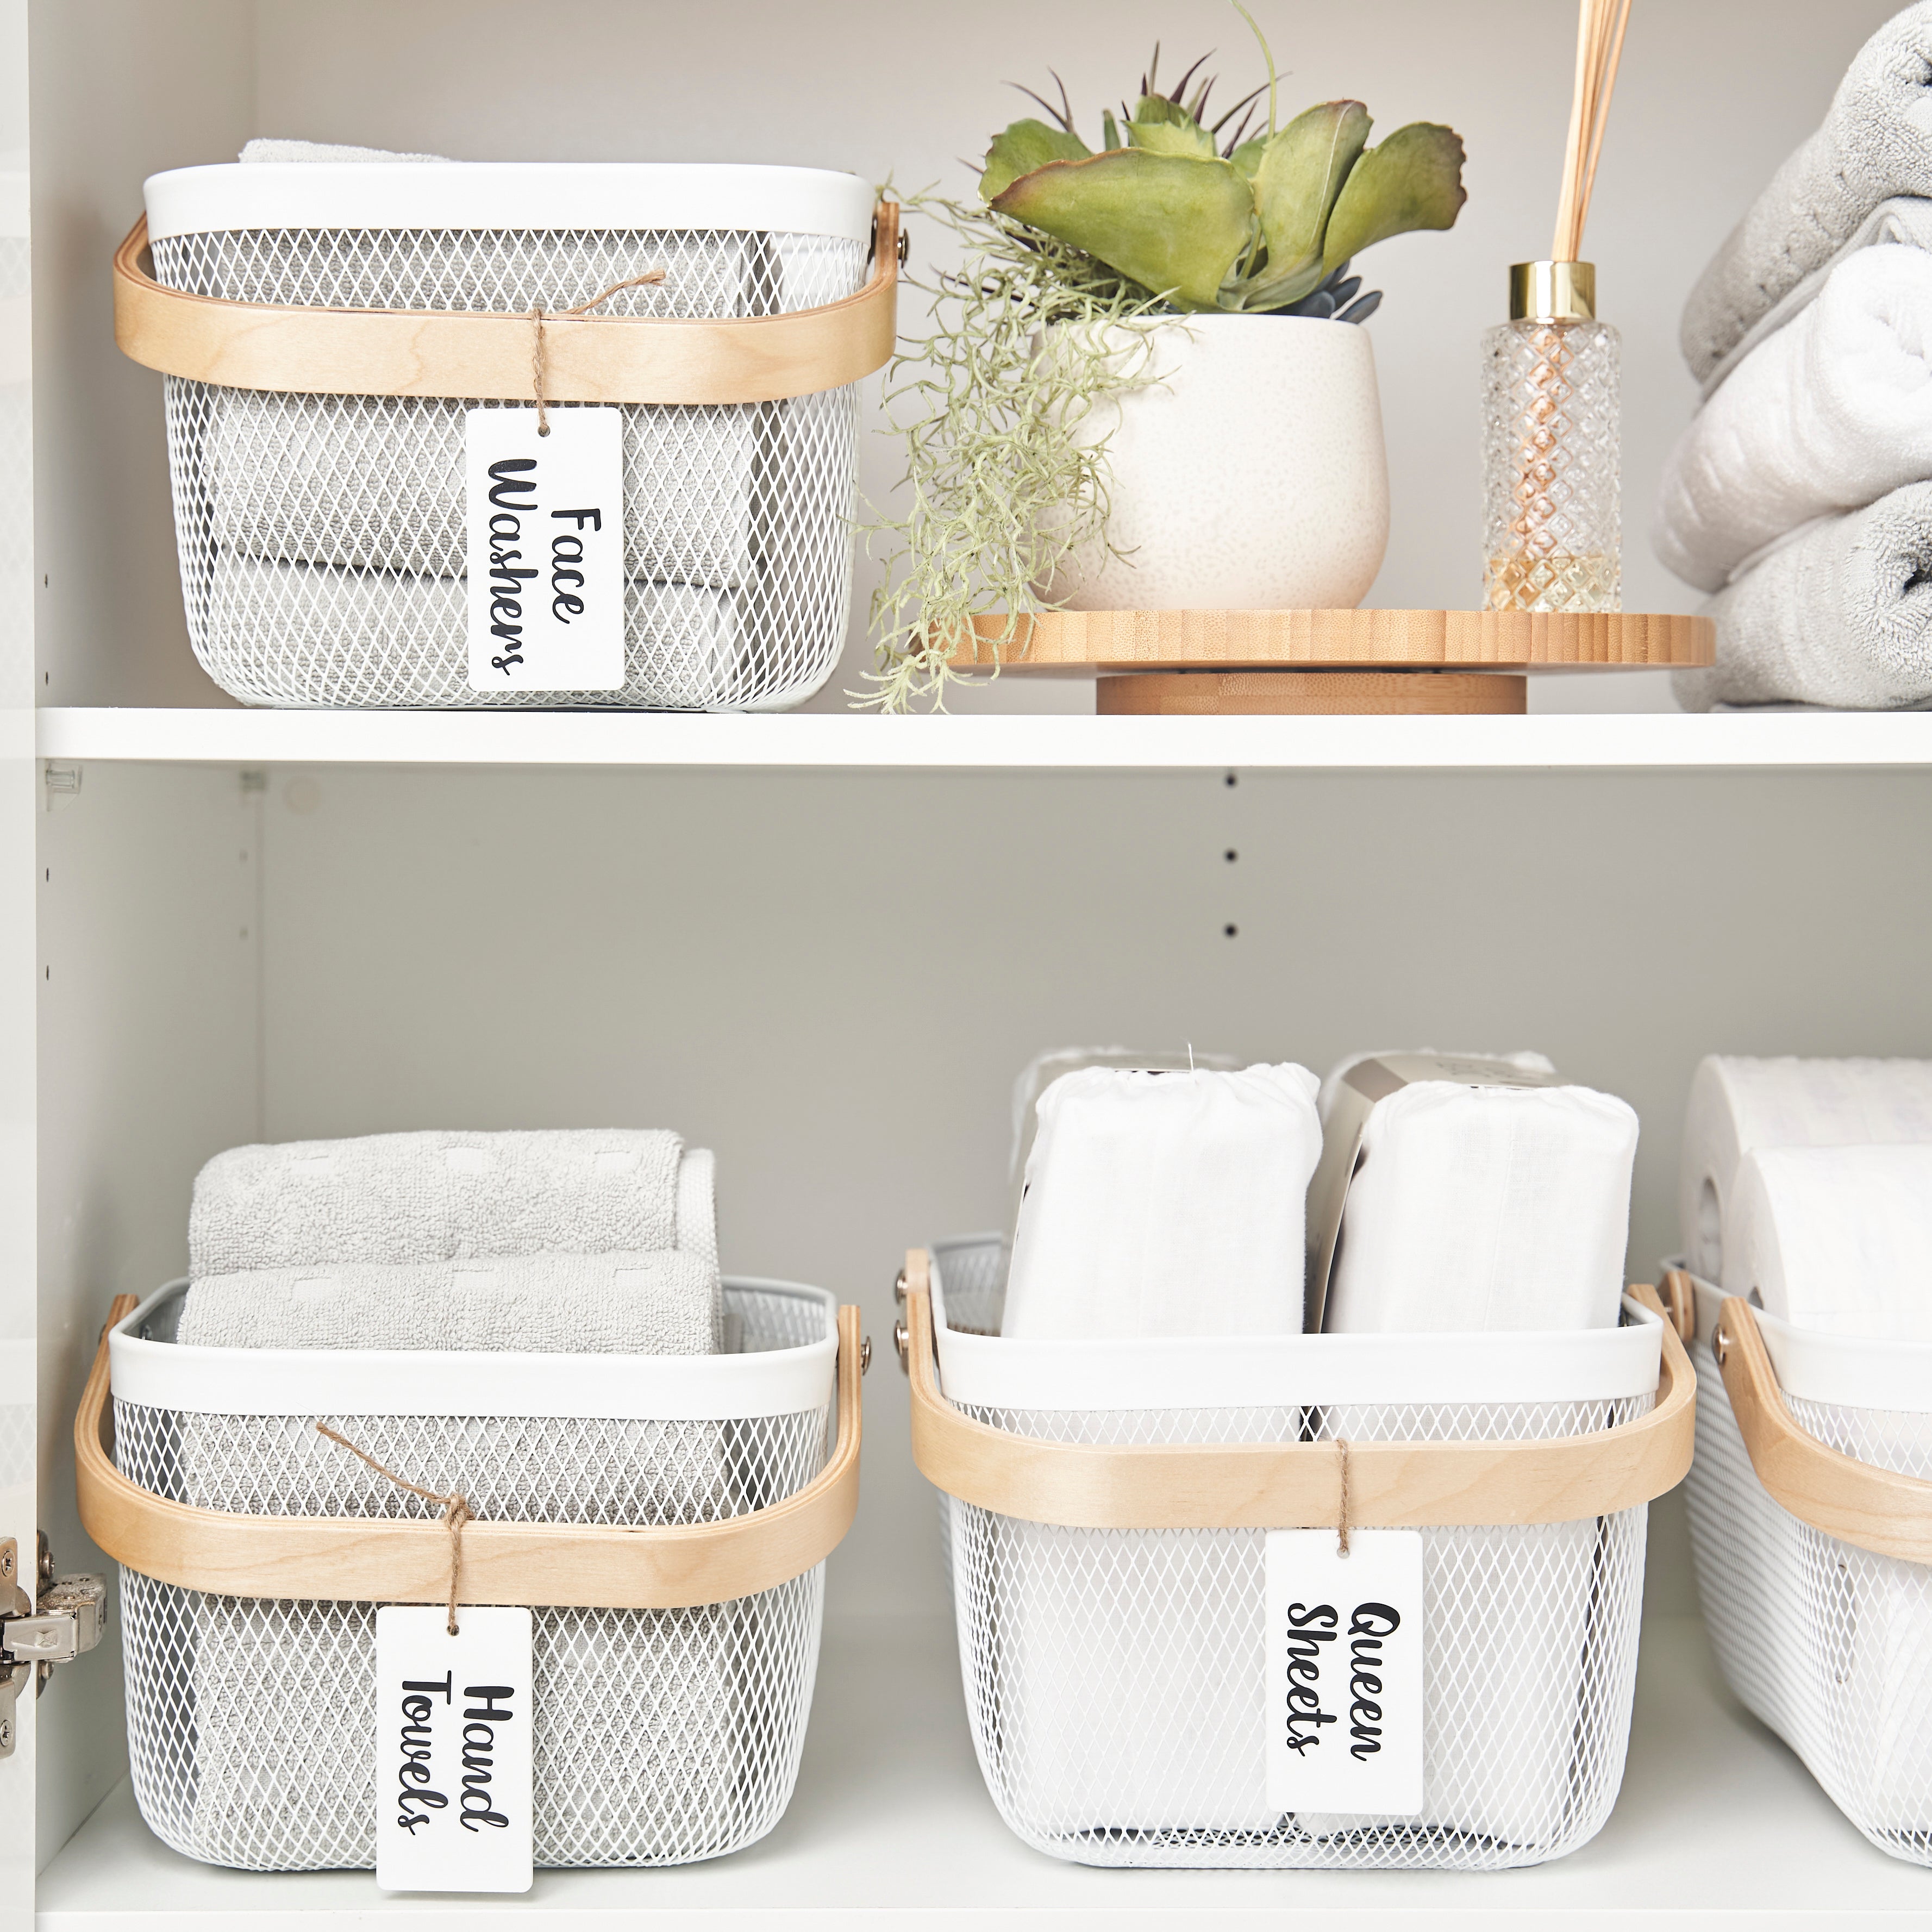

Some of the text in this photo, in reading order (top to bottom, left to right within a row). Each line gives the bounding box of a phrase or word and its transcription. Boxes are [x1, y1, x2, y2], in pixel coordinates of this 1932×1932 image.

[489, 459, 539, 676] Washers
[551, 508, 602, 624] Face
[397, 1670, 452, 1836] Towels
[1286, 1603, 1339, 1757] Sheets
[1347, 1602, 1400, 1761] Queen
[460, 1686, 515, 1833] Hand
